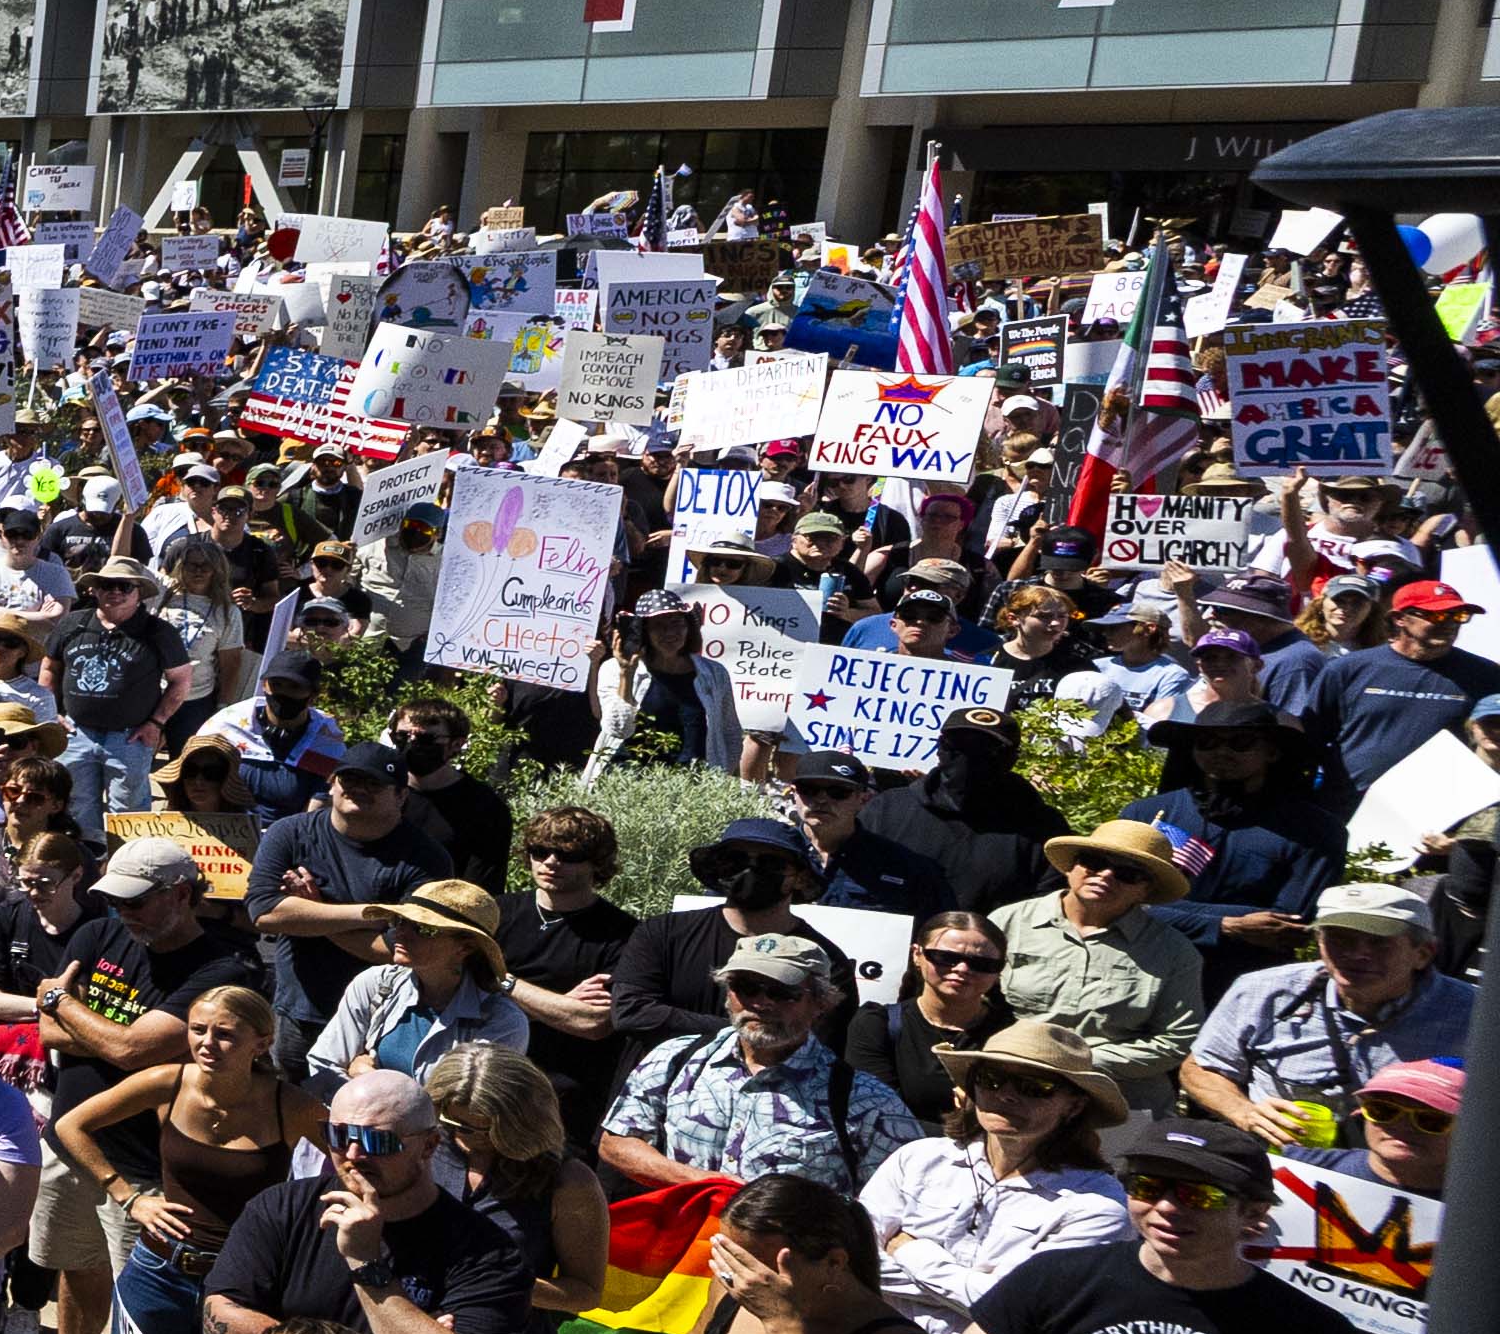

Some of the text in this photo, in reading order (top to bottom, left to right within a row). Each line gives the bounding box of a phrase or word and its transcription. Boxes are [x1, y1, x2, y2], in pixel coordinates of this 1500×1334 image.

[955, 223, 1026, 245] TRUMP
[959, 237, 1031, 258] PIECES
[214, 303, 268, 315] CHECKS
[610, 287, 713, 308] AMERICA:
[640, 310, 681, 326] NO
[136, 334, 202, 351] TEND THAT
[404, 334, 445, 354] NO
[1036, 324, 1061, 339] People
[1223, 321, 1390, 355] IMMIGRANTS
[373, 349, 477, 387] CROWN
[579, 349, 644, 366] IMPEACH
[581, 362, 636, 377] CONVICT
[1023, 352, 1058, 367] KINGS
[1240, 351, 1385, 389] MAKE
[165, 365, 192, 377] NOT
[582, 373, 635, 389] REMOVE
[735, 356, 825, 386] DEPARTMENT
[266, 371, 336, 402] DEATH
[274, 394, 373, 431] LAND OF
[362, 383, 482, 425] CLOWN
[567, 390, 645, 410] NO KINGS
[1236, 393, 1383, 425] AMERICA
[873, 402, 924, 426] NO
[280, 413, 377, 451] PLENTY
[852, 423, 940, 449] FAUX
[1245, 420, 1390, 466] GREAT
[815, 440, 973, 473] KING WAY
[35, 476, 56, 493] YES
[377, 465, 432, 493] PROTECT
[676, 467, 764, 517] DETOX
[362, 482, 437, 518] SEPARATION
[1110, 520, 1186, 536] OVER
[536, 534, 611, 606] Feliz
[500, 575, 594, 615] Cumpleaños
[742, 604, 800, 636] Kings
[738, 640, 797, 661] Police
[733, 659, 793, 680] State
[827, 653, 993, 705] REJECTING
[852, 694, 944, 731] KINGS
[804, 721, 882, 752] SINCE
[110, 818, 144, 838] We
[191, 844, 247, 858] KINGS
[1288, 1267, 1337, 1295] NO
